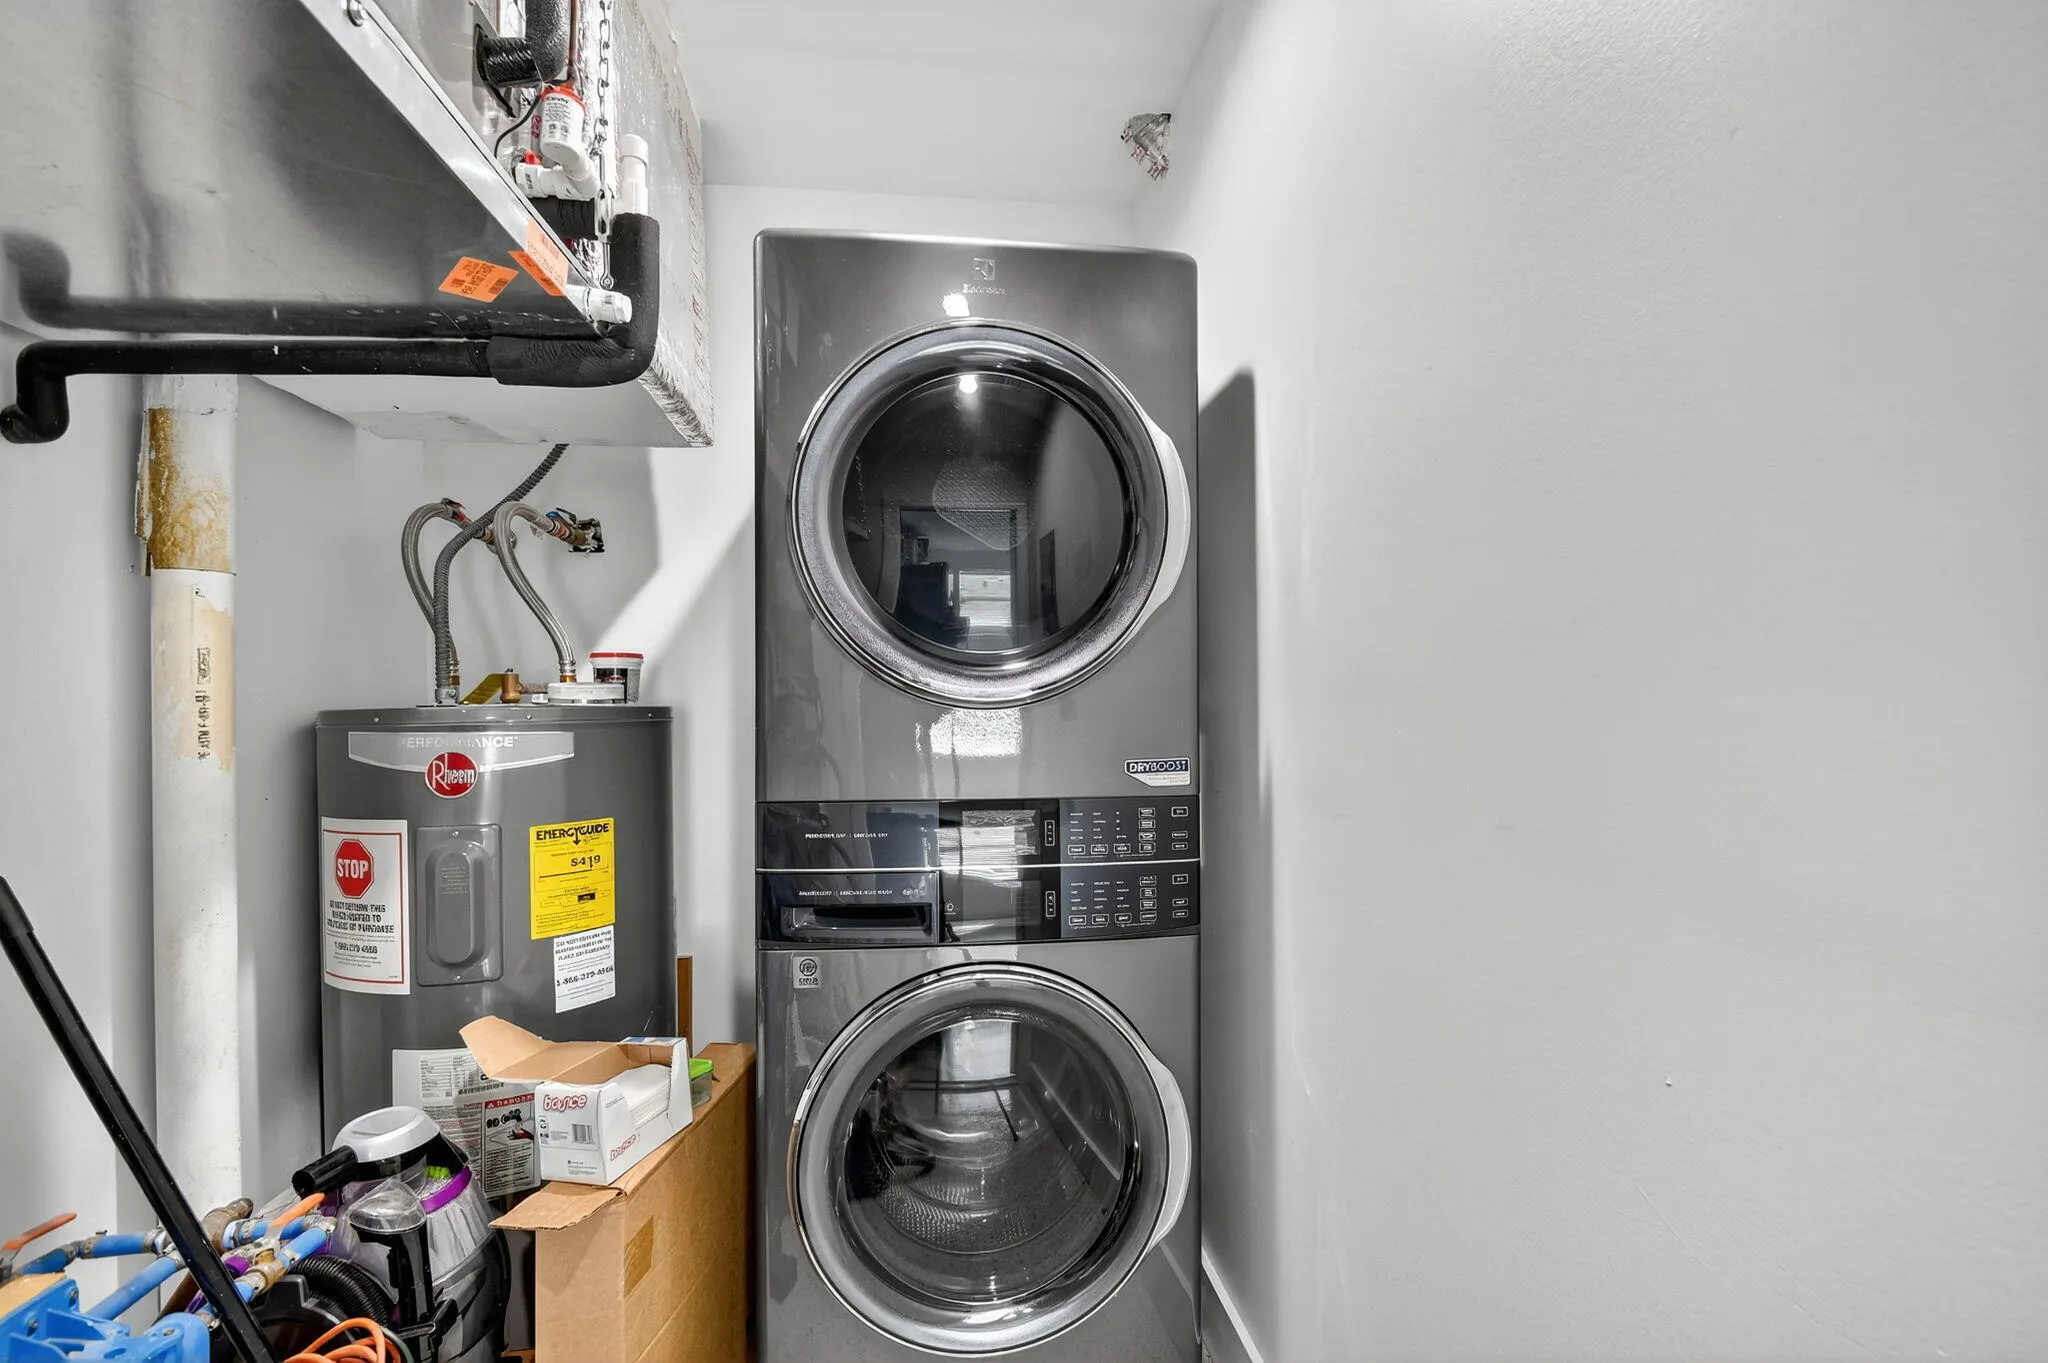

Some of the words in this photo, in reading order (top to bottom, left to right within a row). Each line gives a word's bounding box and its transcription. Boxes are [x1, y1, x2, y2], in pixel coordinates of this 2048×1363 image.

[432, 753, 475, 791] Rheem
[1129, 759, 1187, 773] DRYBOOST
[336, 858, 369, 879] STOP
